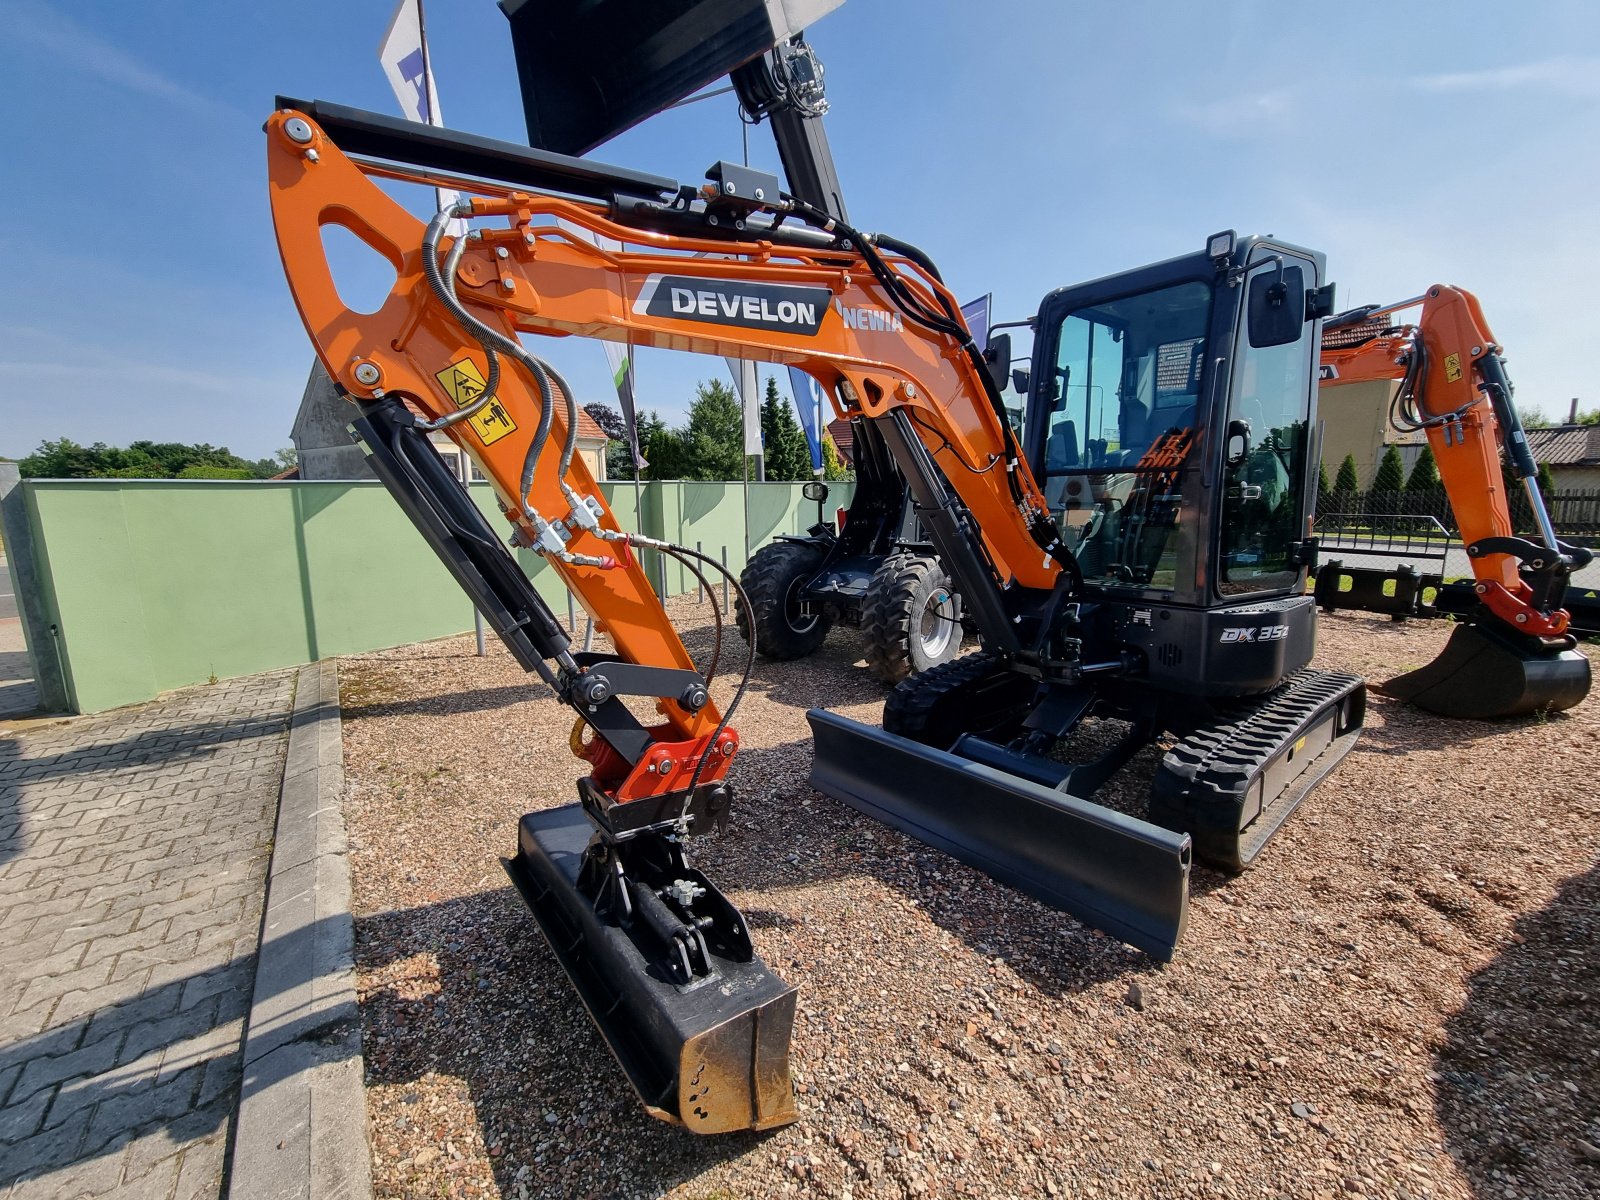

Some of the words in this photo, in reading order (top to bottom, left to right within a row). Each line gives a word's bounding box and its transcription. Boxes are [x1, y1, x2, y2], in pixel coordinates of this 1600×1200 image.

[670, 287, 816, 325] DEVELON
[842, 307, 905, 333] NEWIA
[1220, 628, 1257, 643] DX
